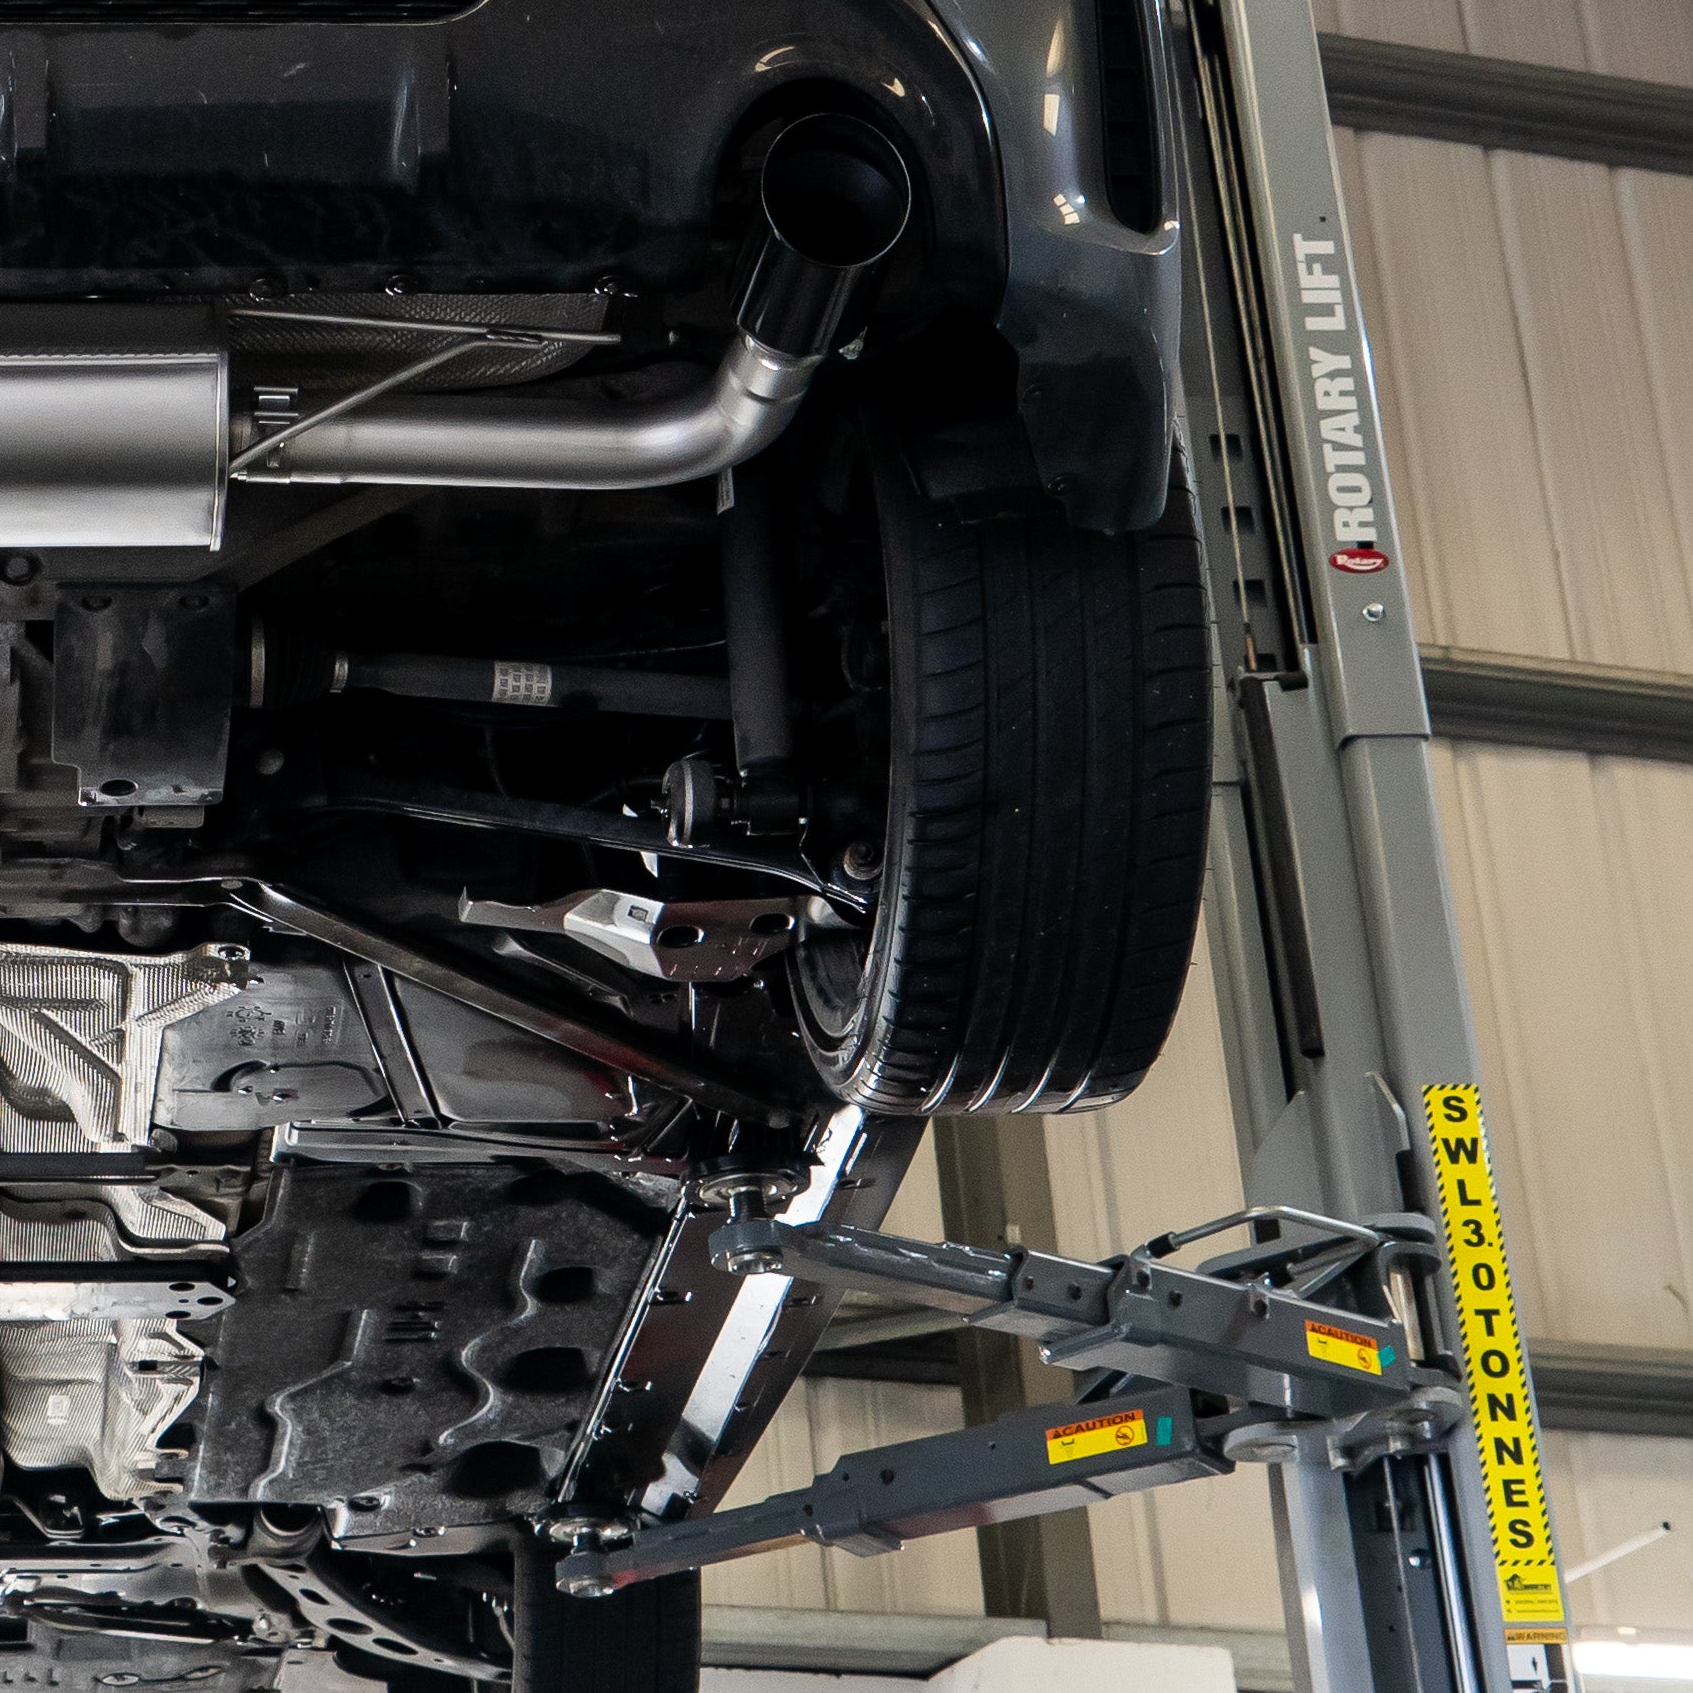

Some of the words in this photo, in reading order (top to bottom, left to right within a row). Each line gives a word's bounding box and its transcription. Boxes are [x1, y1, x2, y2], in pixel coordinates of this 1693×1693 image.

[1293, 233, 1347, 331] LIFT
[1309, 346, 1378, 542] ROTARY
[1318, 1325, 1372, 1348] CAUTION
[1441, 1095, 1482, 1207] SWL
[1475, 1308, 1536, 1549] TONNES
[1063, 1412, 1136, 1436] CAUTION
